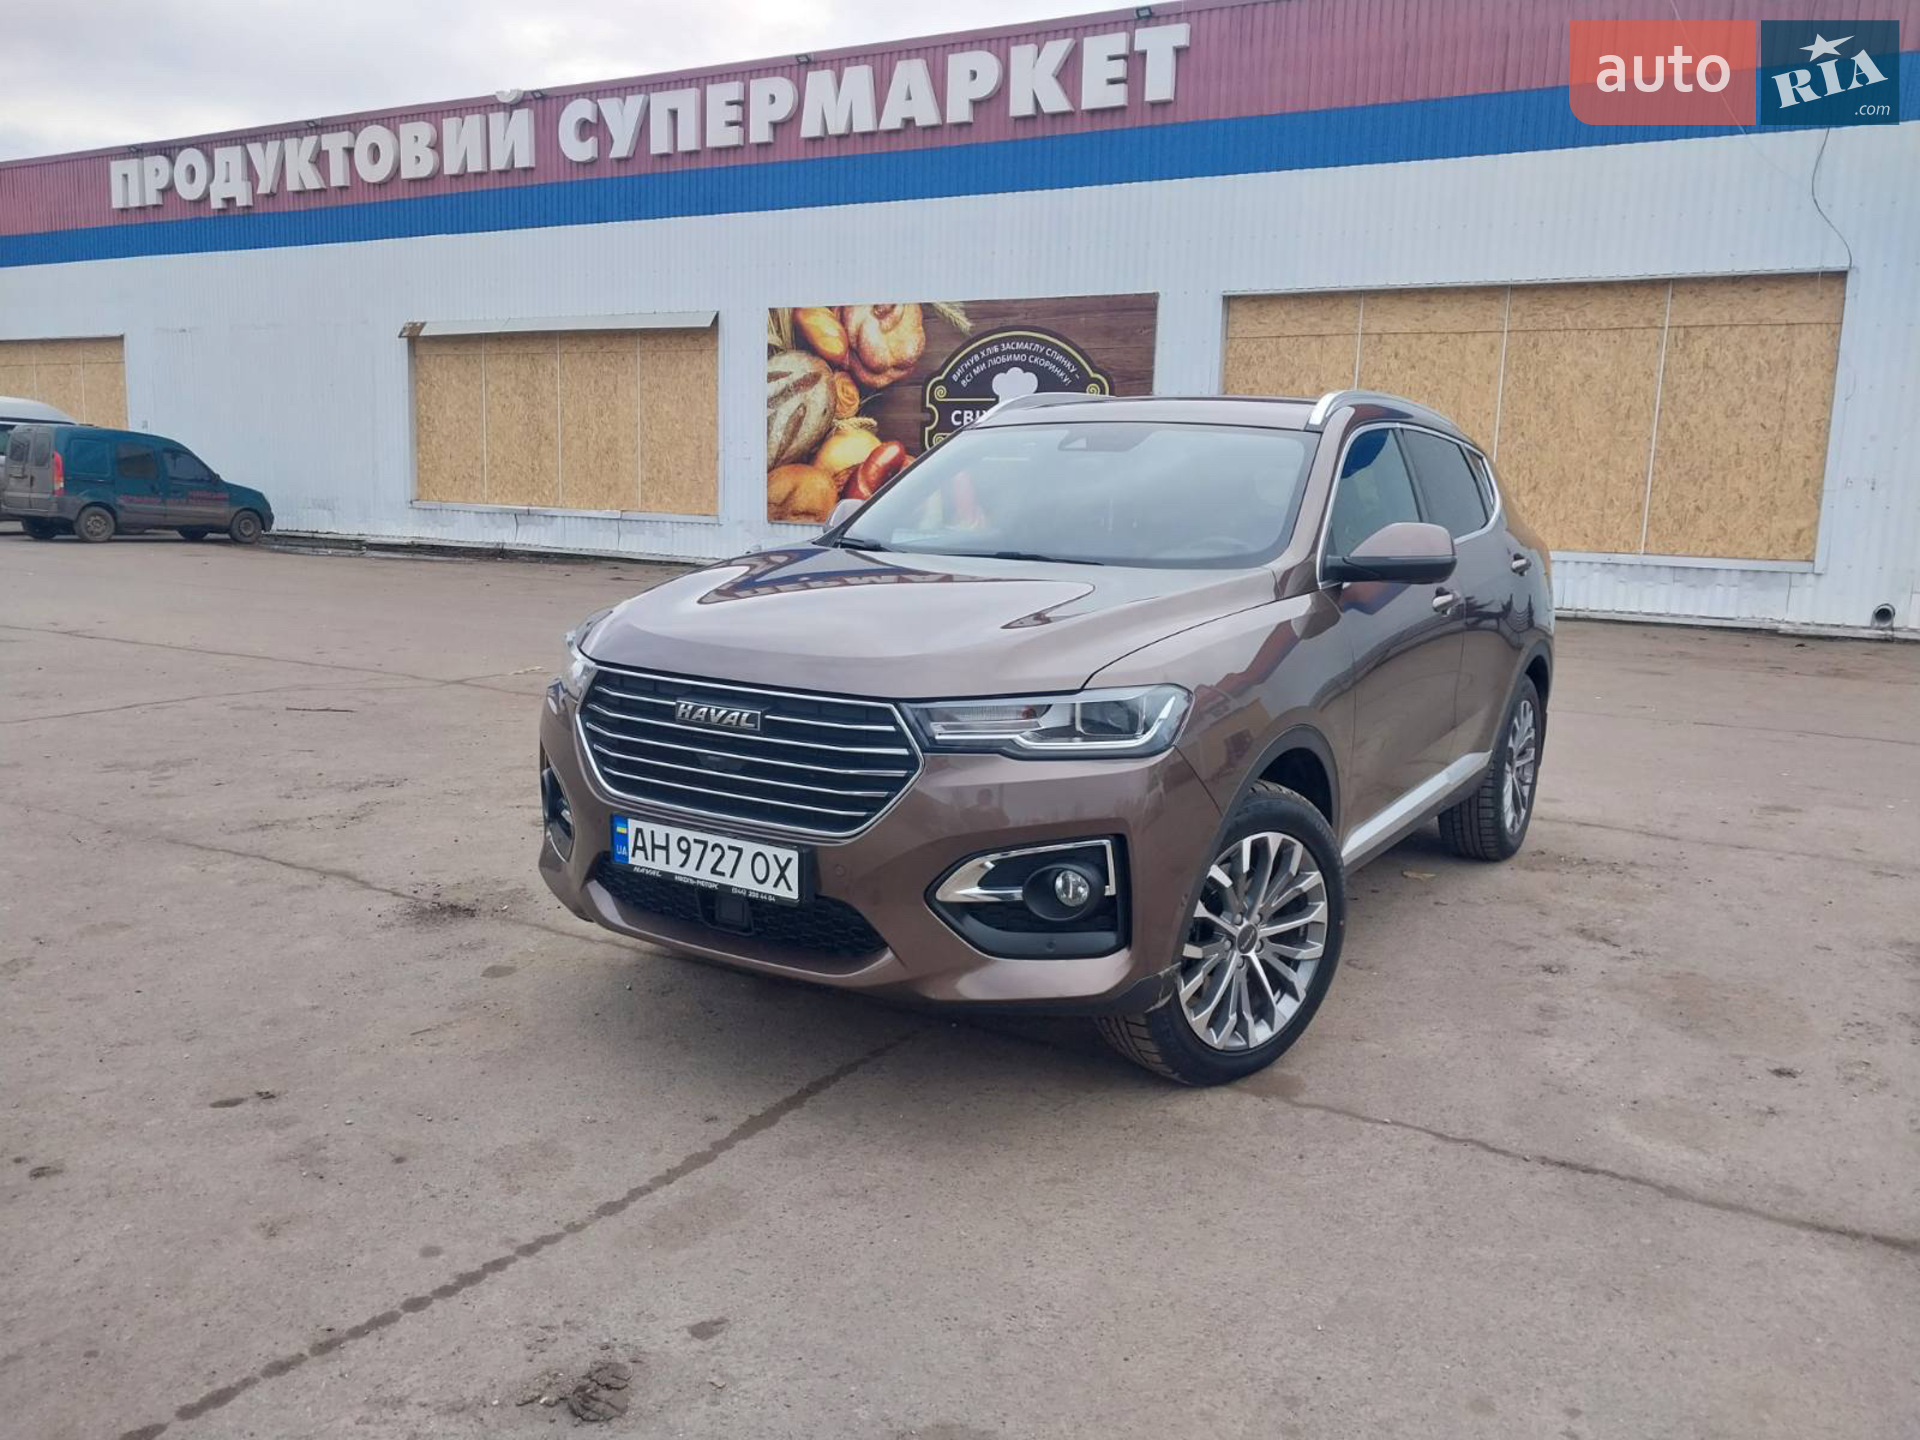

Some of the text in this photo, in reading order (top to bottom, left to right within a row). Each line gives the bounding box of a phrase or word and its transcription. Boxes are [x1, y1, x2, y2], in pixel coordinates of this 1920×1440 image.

[110, 22, 1191, 210] ПРОДУКТОВИЙ СУПЕРМАРКЕТ
[952, 353, 980, 382] ВИГНУВ
[980, 345, 1000, 358] ХЛІБ
[1001, 341, 1045, 353] ЗАСМАГЛУ
[1045, 348, 1078, 373] СПИНКУ
[961, 354, 1072, 388] ВСІ МИ ЛЮБИМО СКОРИНКУ!
[951, 410, 989, 426] СВІ
[677, 703, 755, 728] HAVAL
[616, 845, 628, 856] UA
[631, 827, 793, 891] AH 9727 OX
